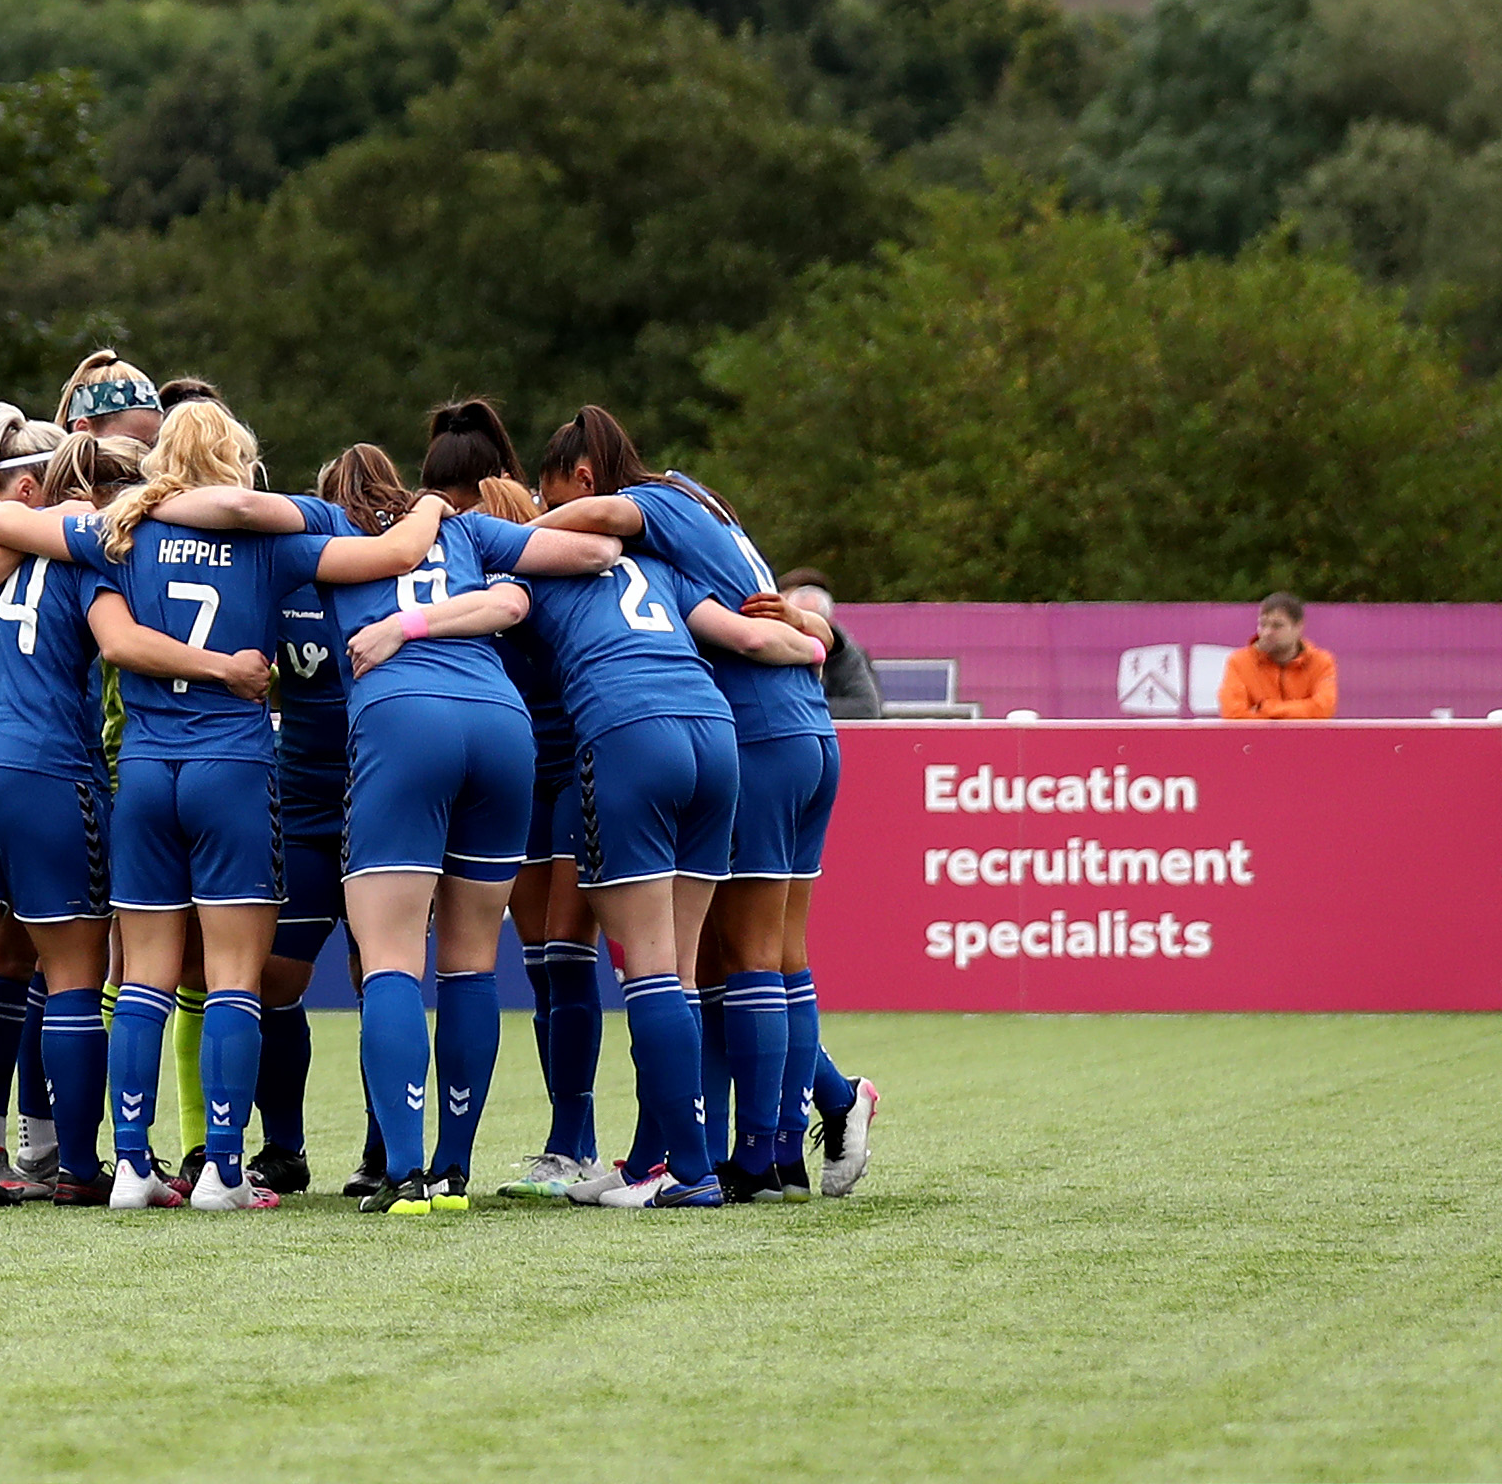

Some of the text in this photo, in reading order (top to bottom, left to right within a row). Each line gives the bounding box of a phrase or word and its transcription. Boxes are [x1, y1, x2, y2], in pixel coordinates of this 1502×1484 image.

[157, 538, 233, 567] HEPPLE
[168, 580, 220, 694] 7
[924, 765, 1198, 813] Education
[924, 836, 1254, 885] recruitment
[924, 908, 1214, 970] specialists
